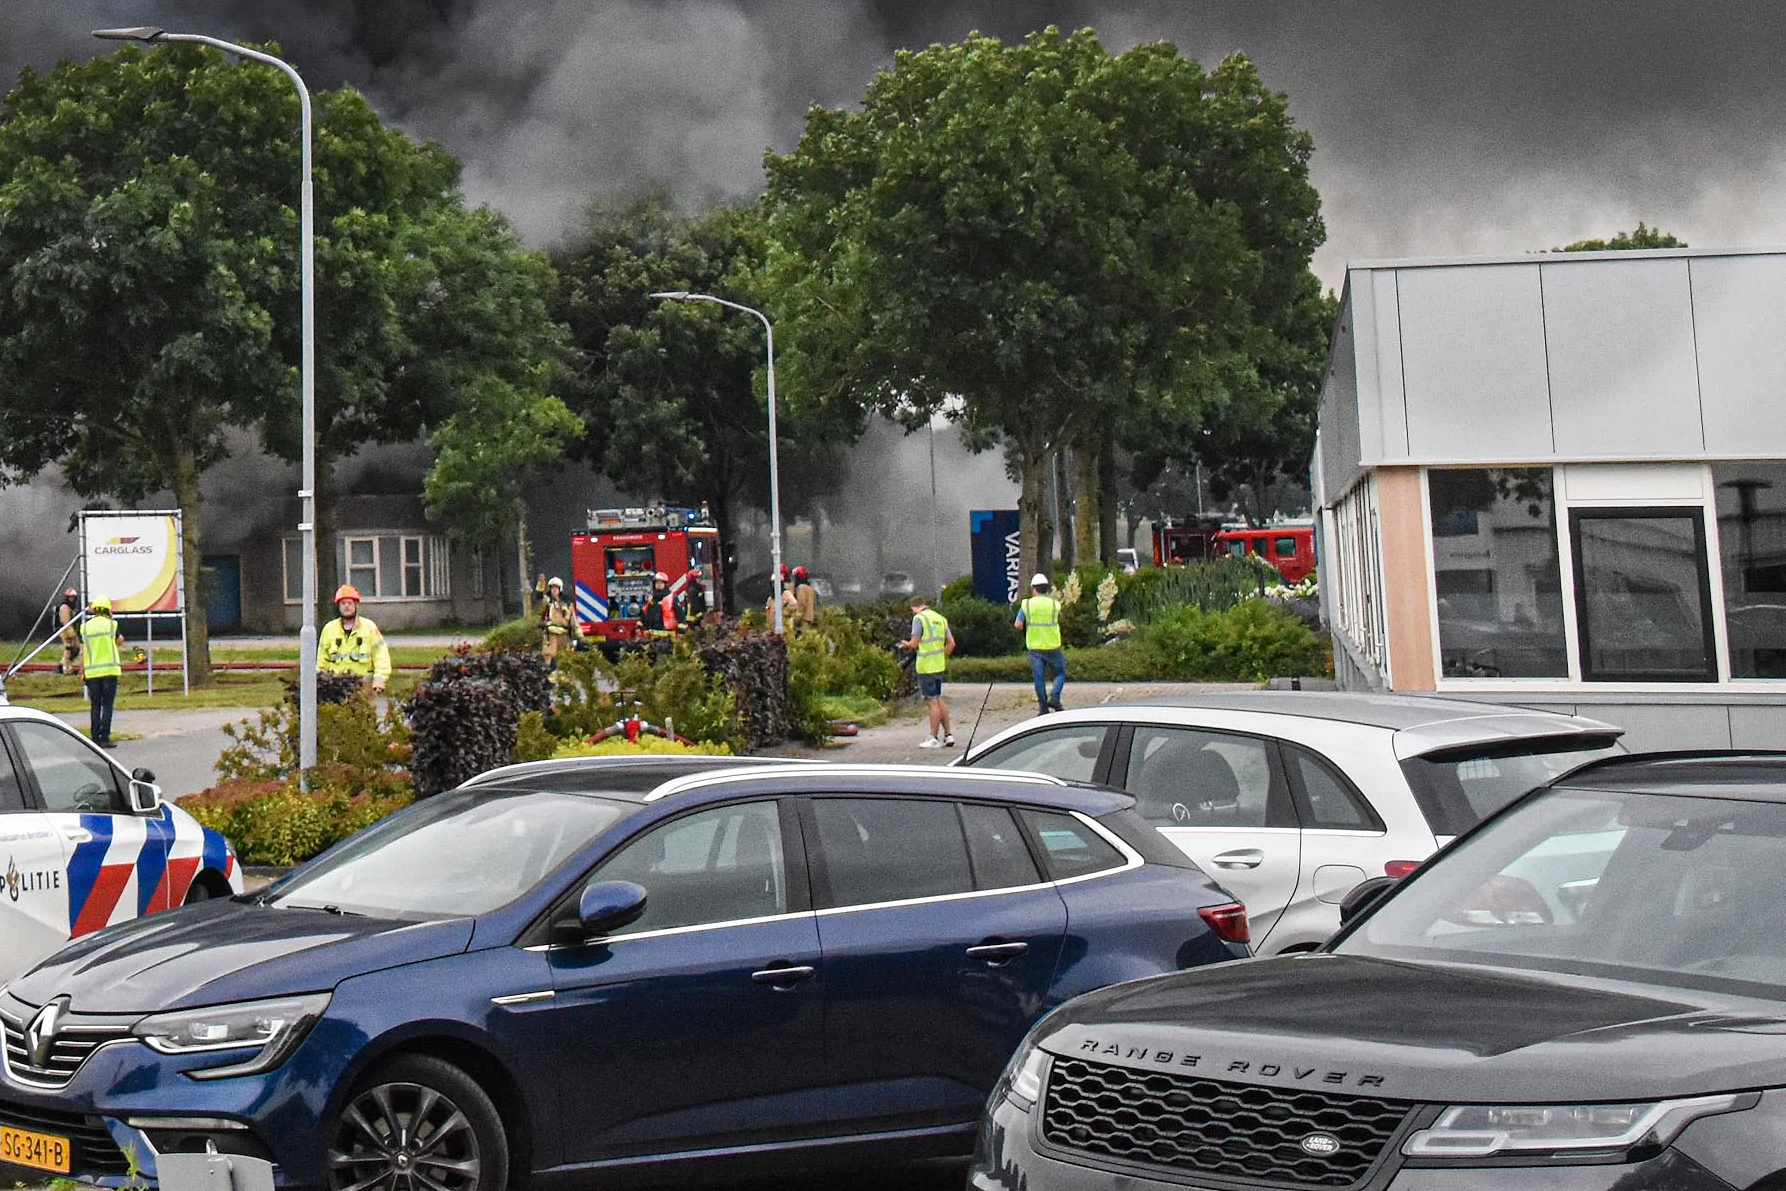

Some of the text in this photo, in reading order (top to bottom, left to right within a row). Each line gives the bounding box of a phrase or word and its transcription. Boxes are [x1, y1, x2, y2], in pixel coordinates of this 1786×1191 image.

[94, 545, 153, 555] CARGLASS
[1080, 1039, 1385, 1088] RANGE ROVER
[4, 1131, 63, 1166] SG-341-B
